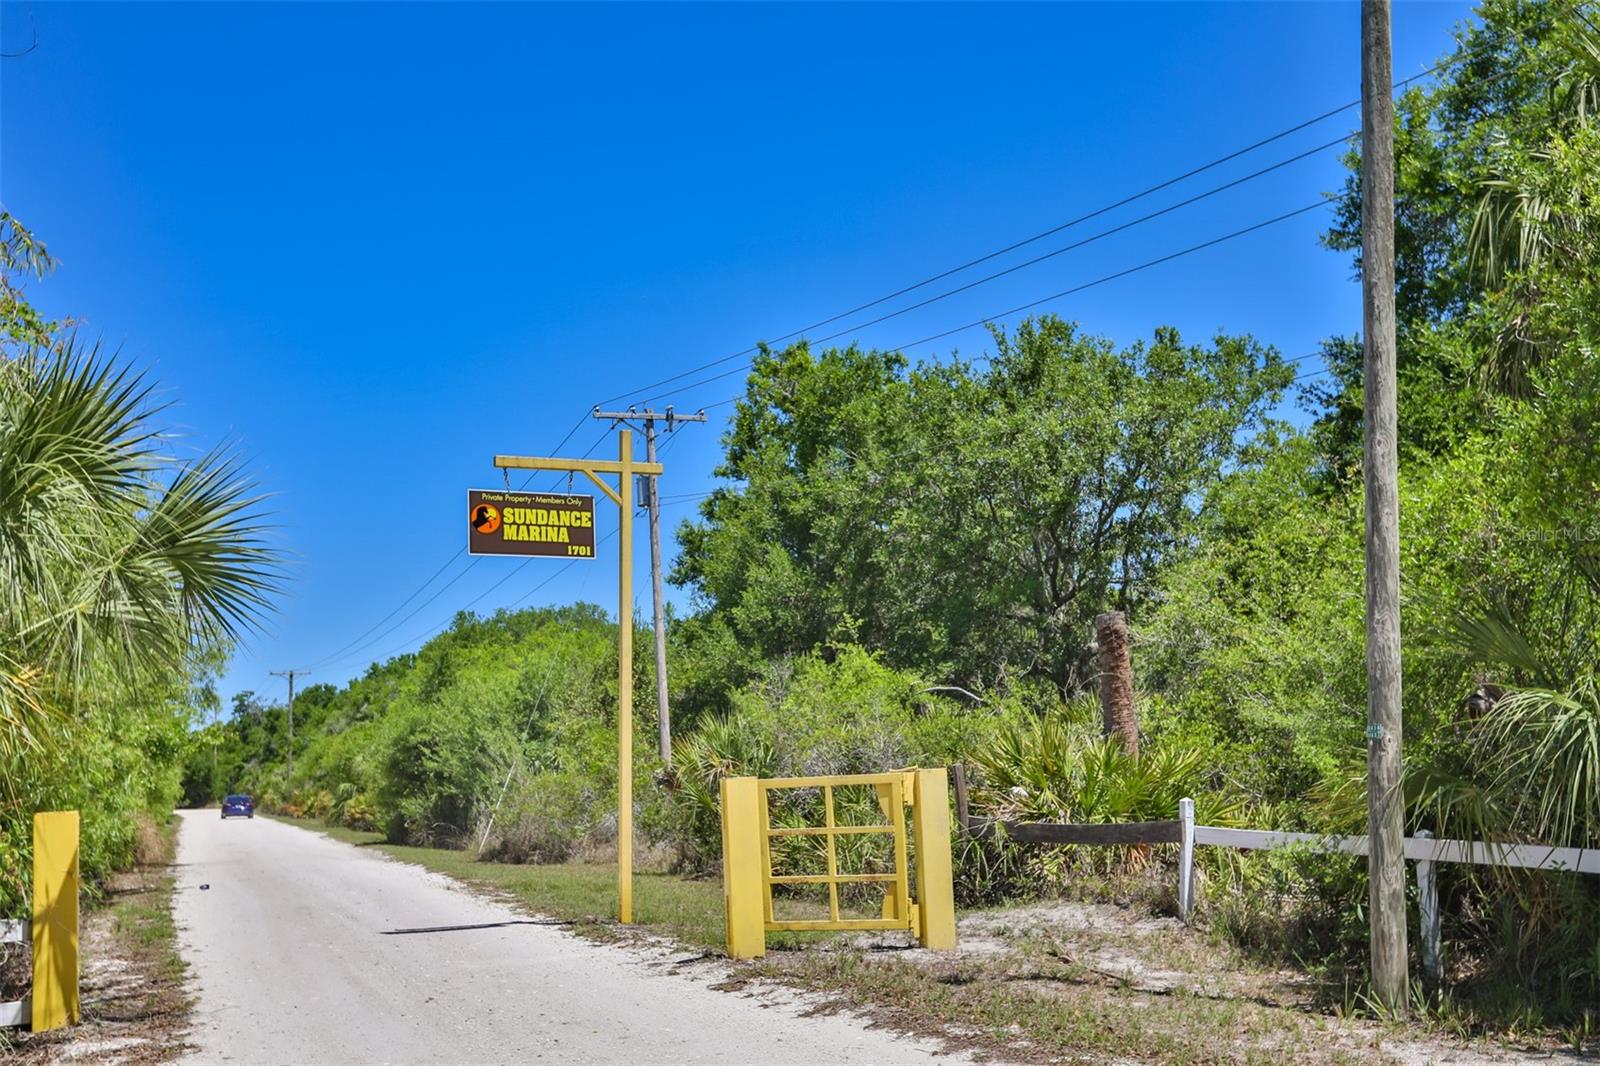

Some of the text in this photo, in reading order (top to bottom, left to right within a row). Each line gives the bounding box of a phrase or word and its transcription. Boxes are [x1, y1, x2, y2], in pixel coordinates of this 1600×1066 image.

[481, 493, 582, 506] Private Property Members Only
[503, 507, 592, 527] SUNDANCE
[503, 524, 569, 543] MARINA
[567, 545, 591, 556] 1701
